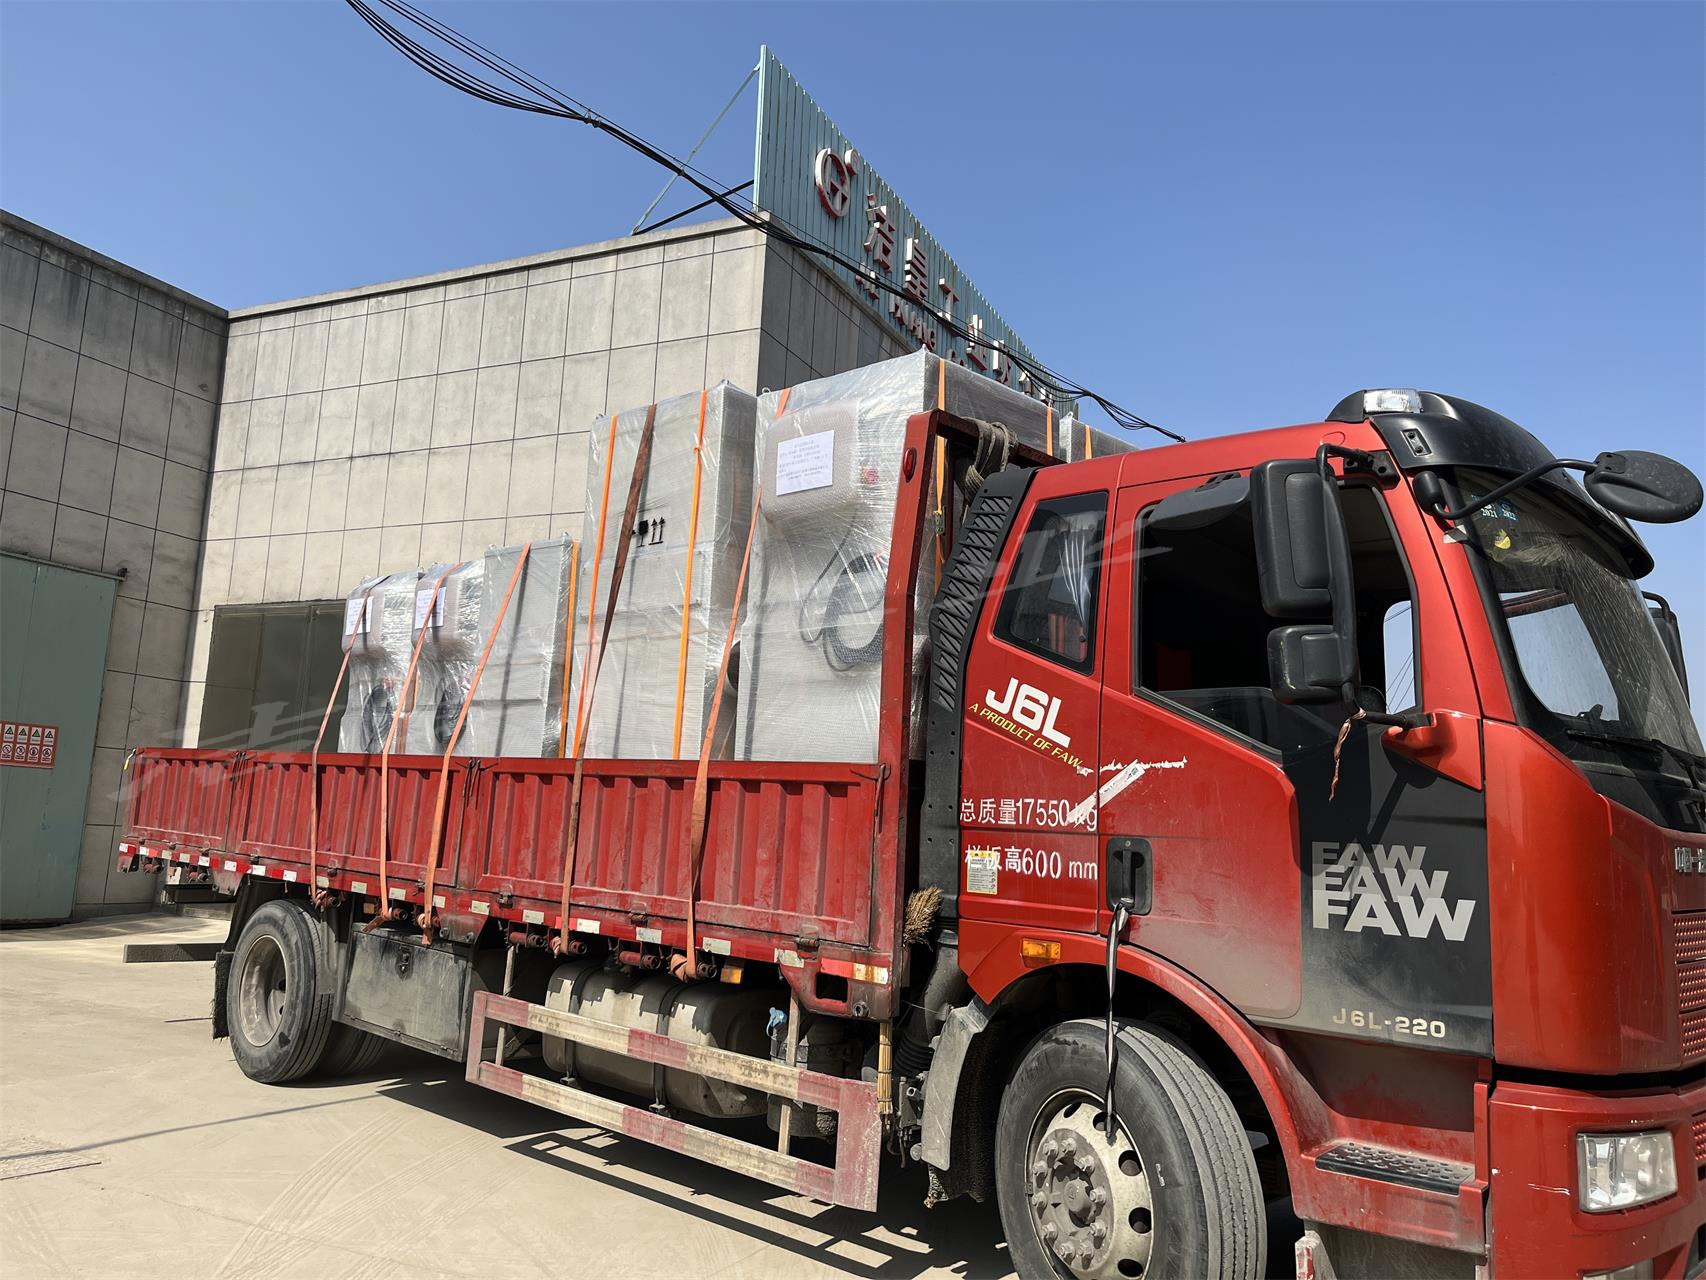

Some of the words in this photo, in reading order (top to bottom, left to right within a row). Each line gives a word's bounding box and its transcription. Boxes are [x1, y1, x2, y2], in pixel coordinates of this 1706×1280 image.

[968, 703, 979, 713] A
[979, 708, 1034, 741] PRODUCT
[1033, 737, 1053, 751] OF
[1051, 747, 1083, 768] FAW
[985, 677, 1071, 748] J6L
[1068, 860, 1098, 881] mm
[1312, 889, 1476, 942] FAW
[1333, 1008, 1446, 1038] J6L-220
